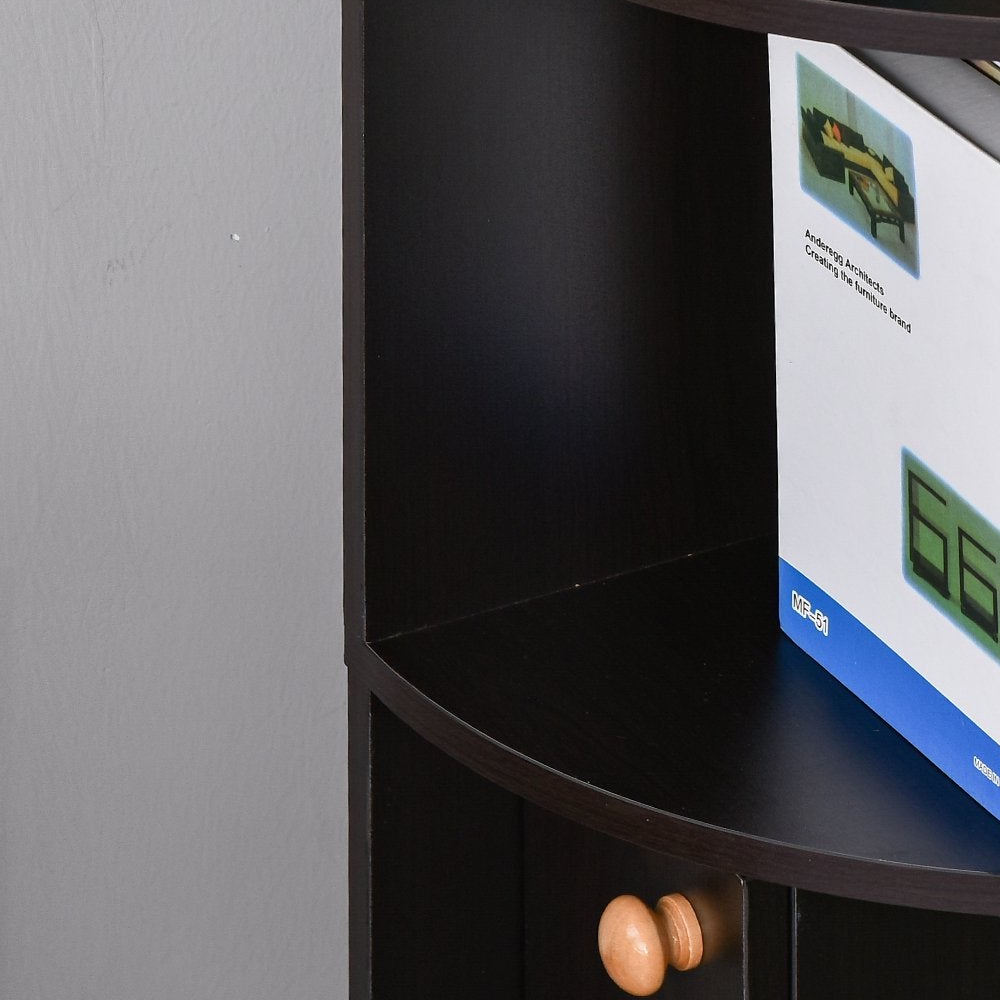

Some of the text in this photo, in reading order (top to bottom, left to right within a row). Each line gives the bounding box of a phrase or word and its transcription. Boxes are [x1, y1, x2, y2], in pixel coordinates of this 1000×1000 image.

[805, 228, 885, 296] Anderegg Architects
[805, 244, 912, 334] Creating the furniture brand
[792, 590, 829, 637] MF-51
